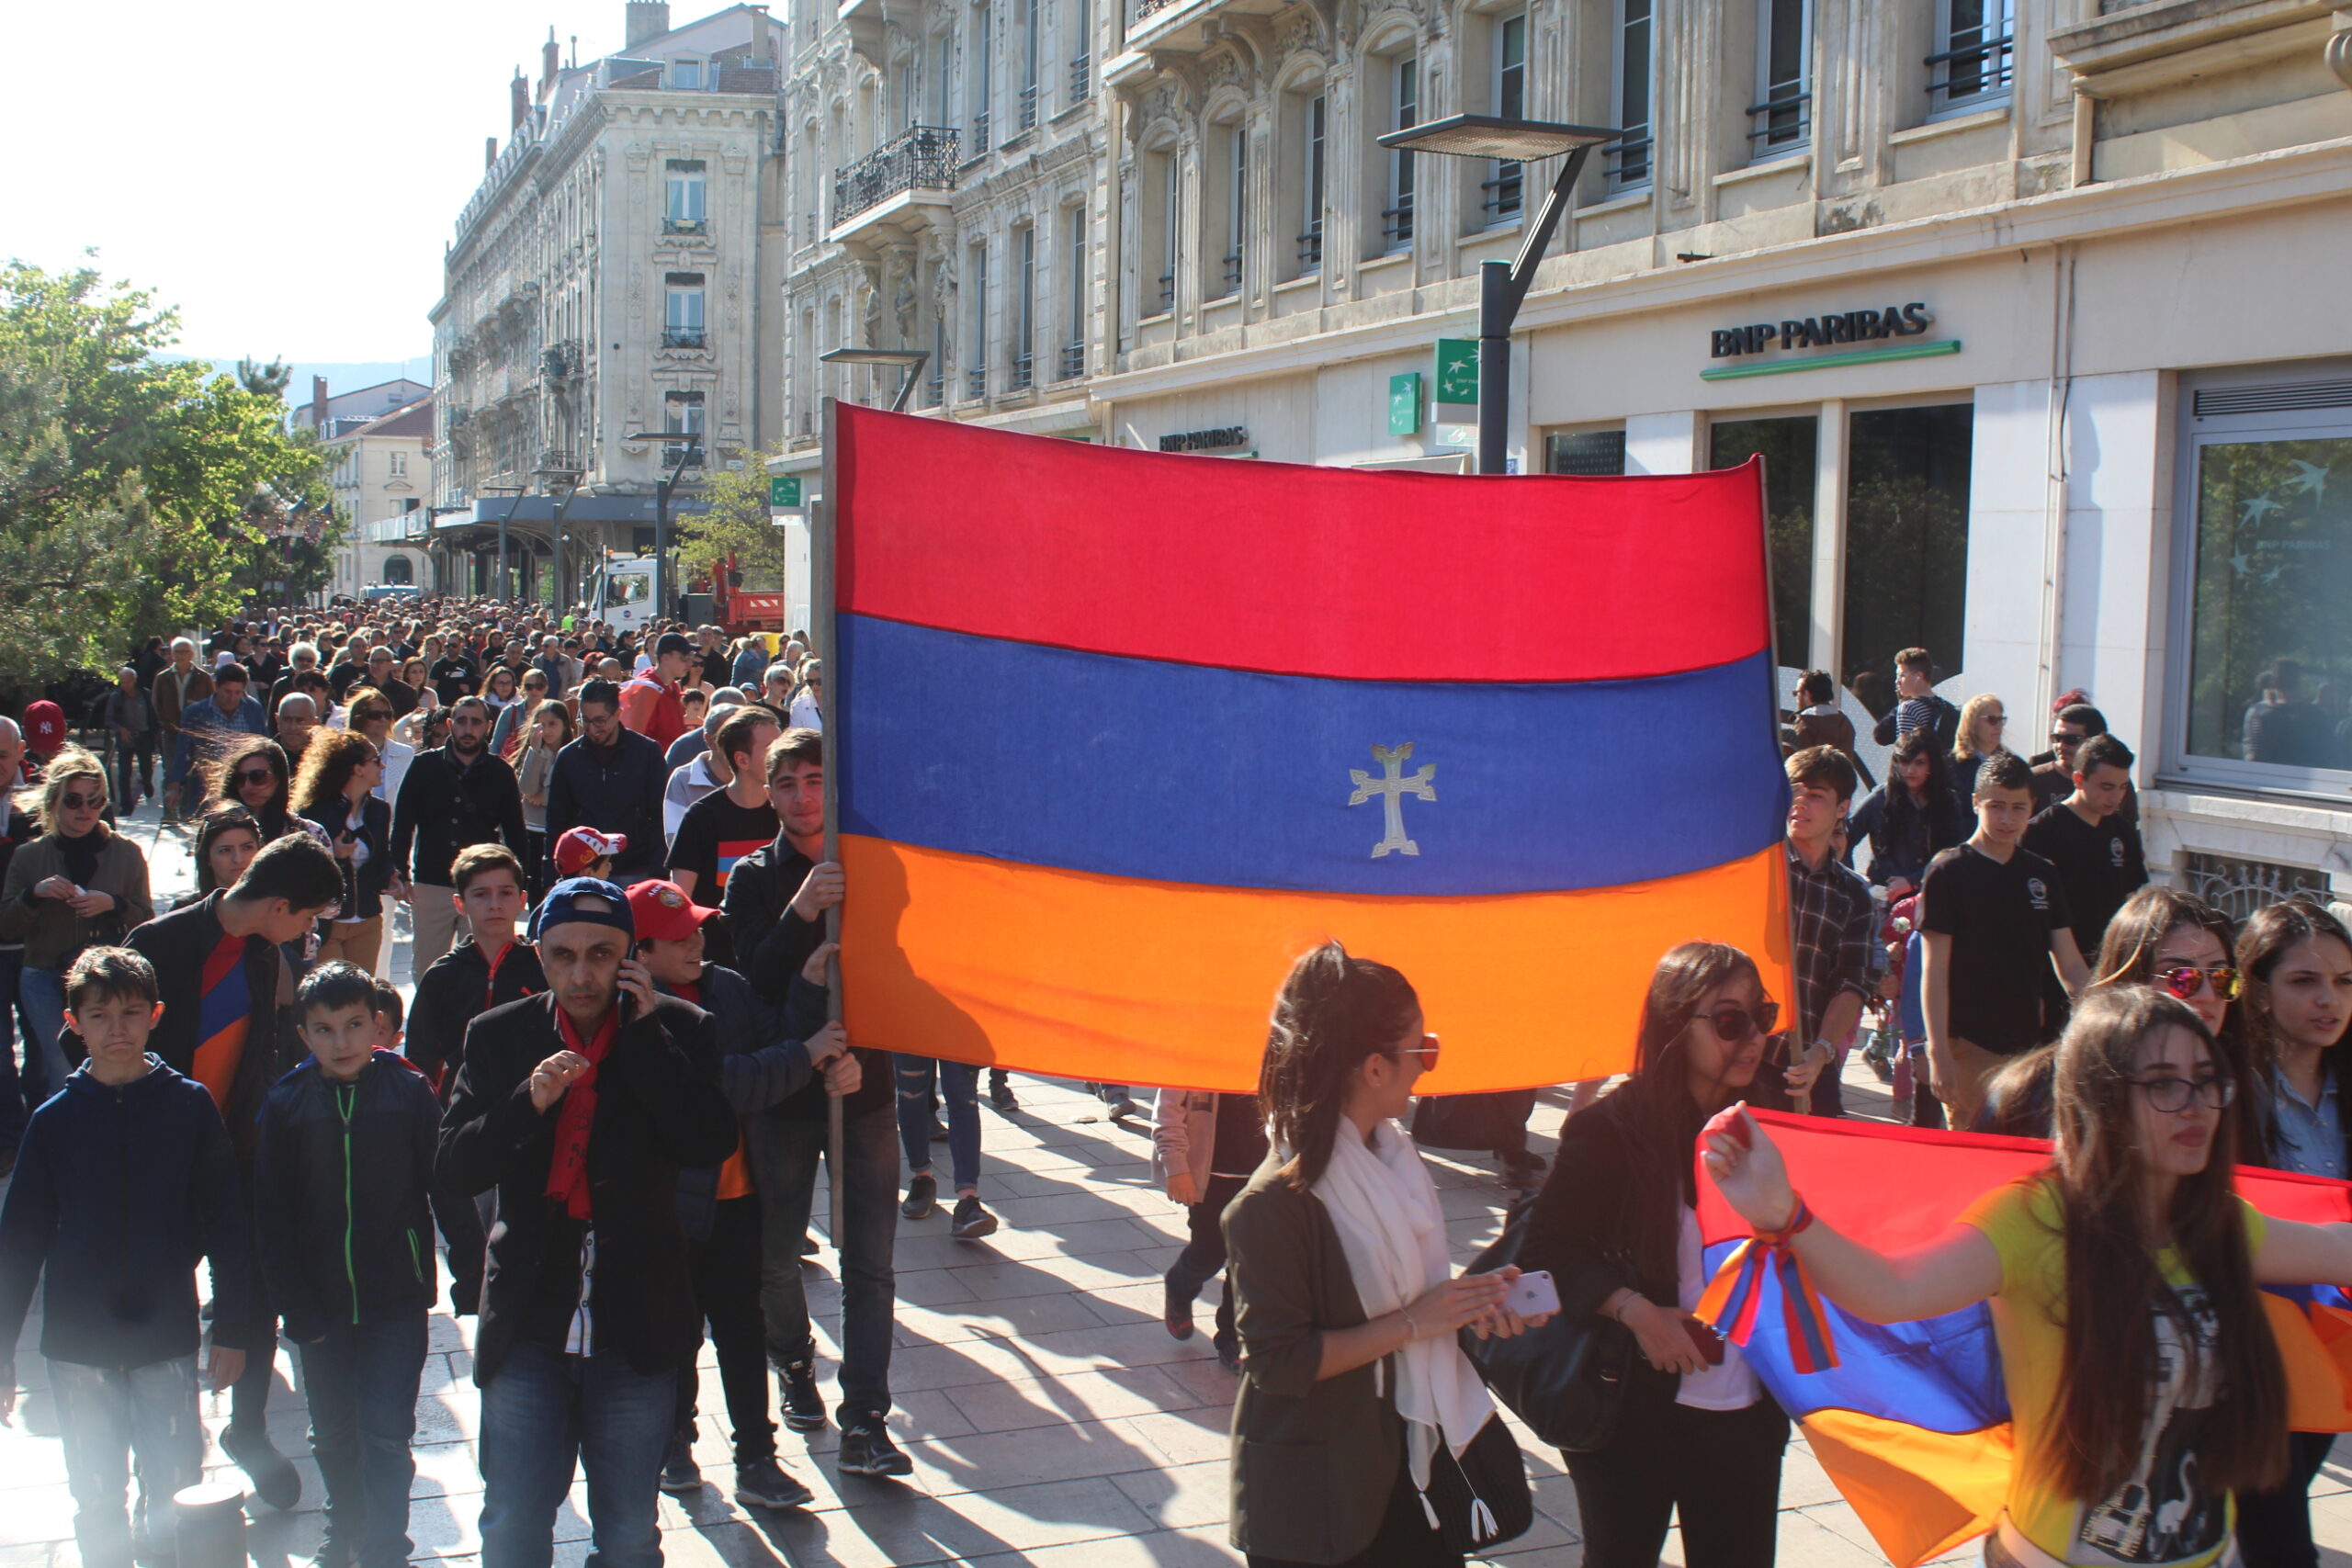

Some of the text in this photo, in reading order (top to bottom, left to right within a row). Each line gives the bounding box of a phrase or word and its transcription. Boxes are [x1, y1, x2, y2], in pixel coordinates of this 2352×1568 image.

[1711, 302, 1928, 358] BNP PARIBAS
[1159, 425, 1244, 452] BNP PARIBAS
